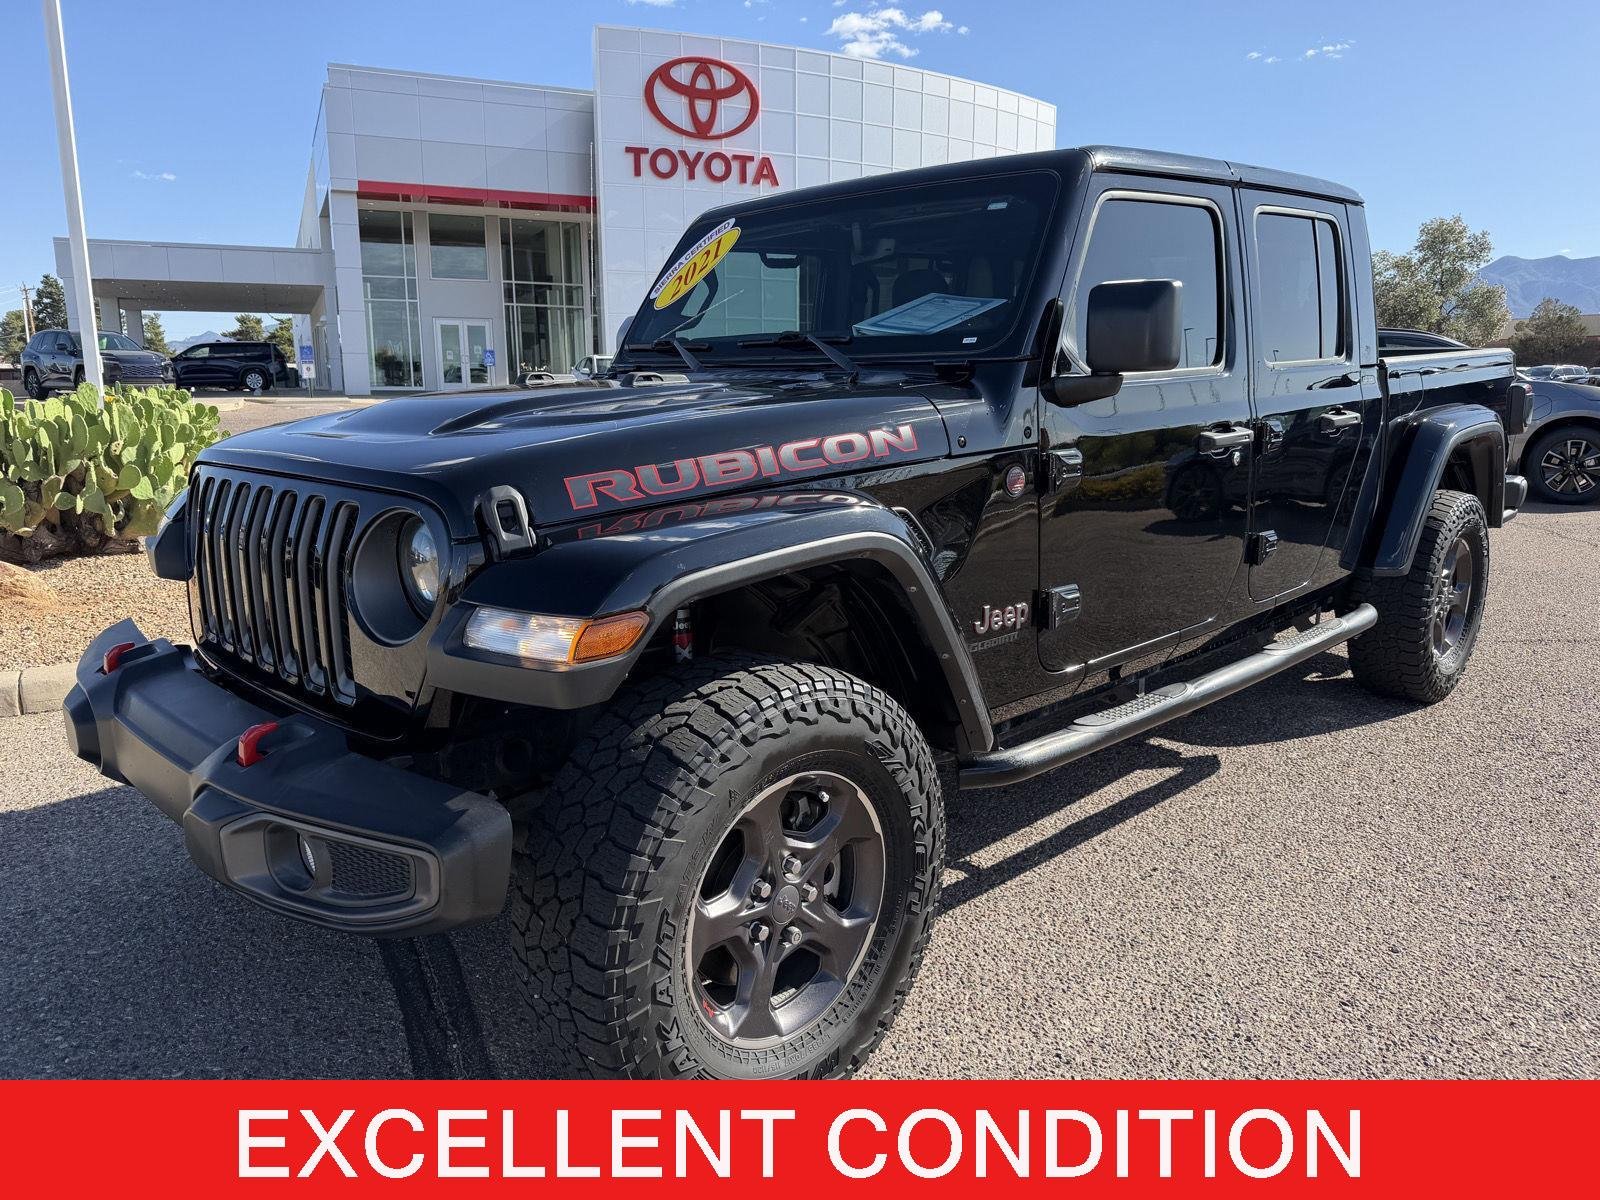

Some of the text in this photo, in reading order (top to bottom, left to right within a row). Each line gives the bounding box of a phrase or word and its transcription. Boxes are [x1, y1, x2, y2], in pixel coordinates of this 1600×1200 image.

[625, 146, 779, 187] TOYOTA
[654, 221, 731, 294] SIERRA CERTIFIED
[670, 237, 723, 300] 2021
[563, 424, 918, 510] RUBICON
[973, 602, 1029, 634] Jeep
